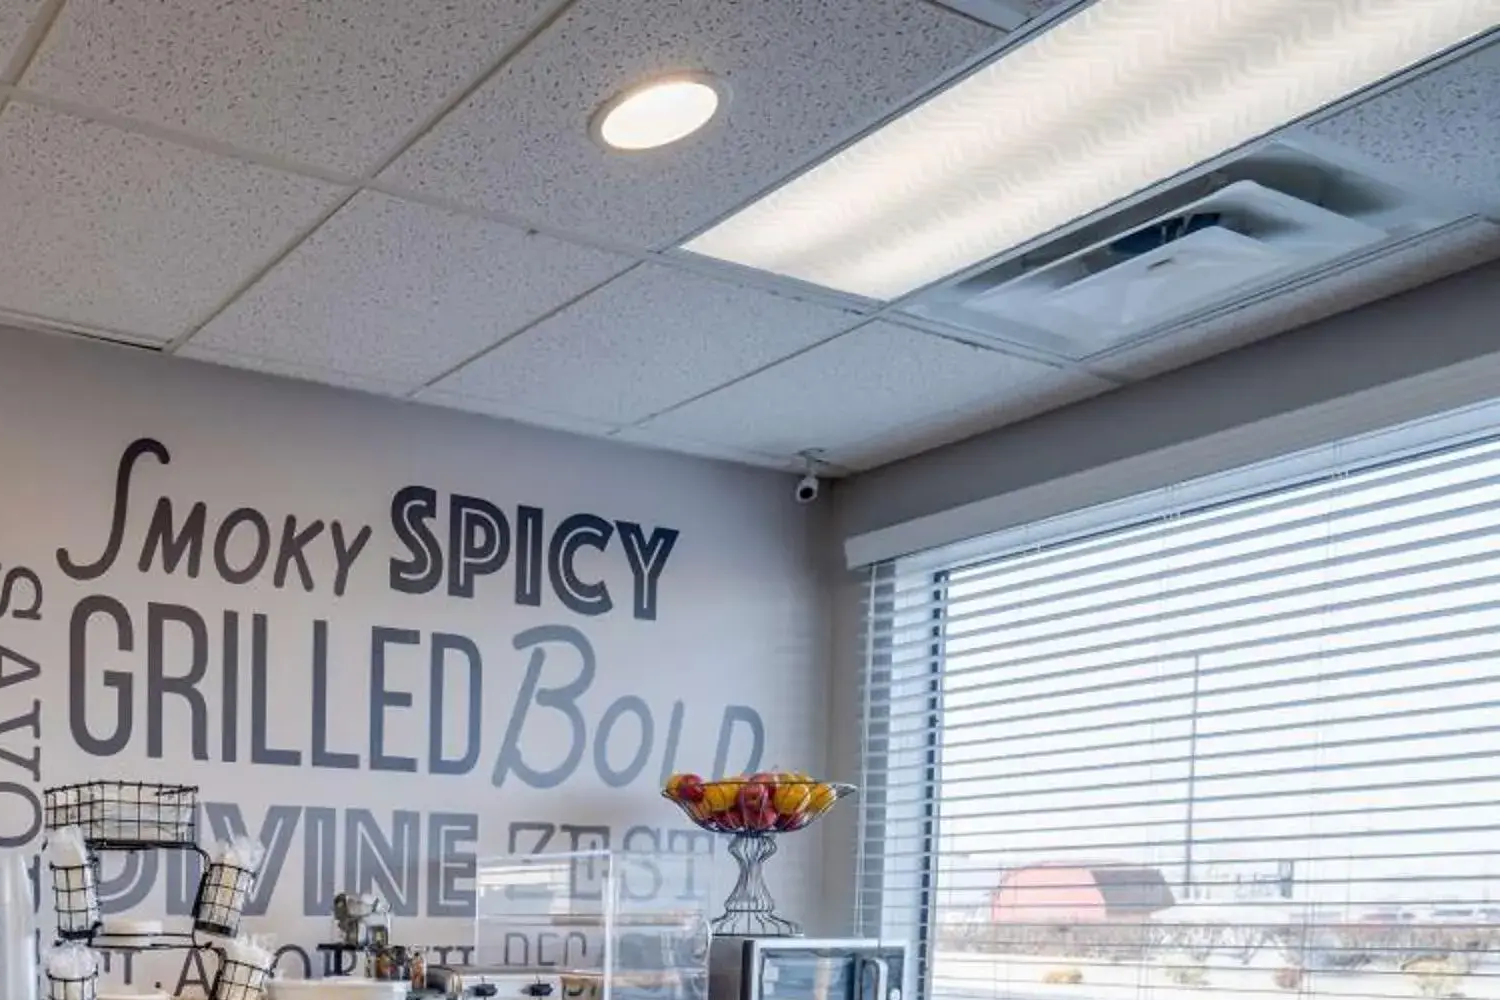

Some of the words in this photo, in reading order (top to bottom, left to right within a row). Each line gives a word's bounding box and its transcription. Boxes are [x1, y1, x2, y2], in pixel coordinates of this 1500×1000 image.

[389, 485, 680, 621] SPICY
[69, 594, 482, 776] GRILLED
[508, 821, 717, 901] ZEST
